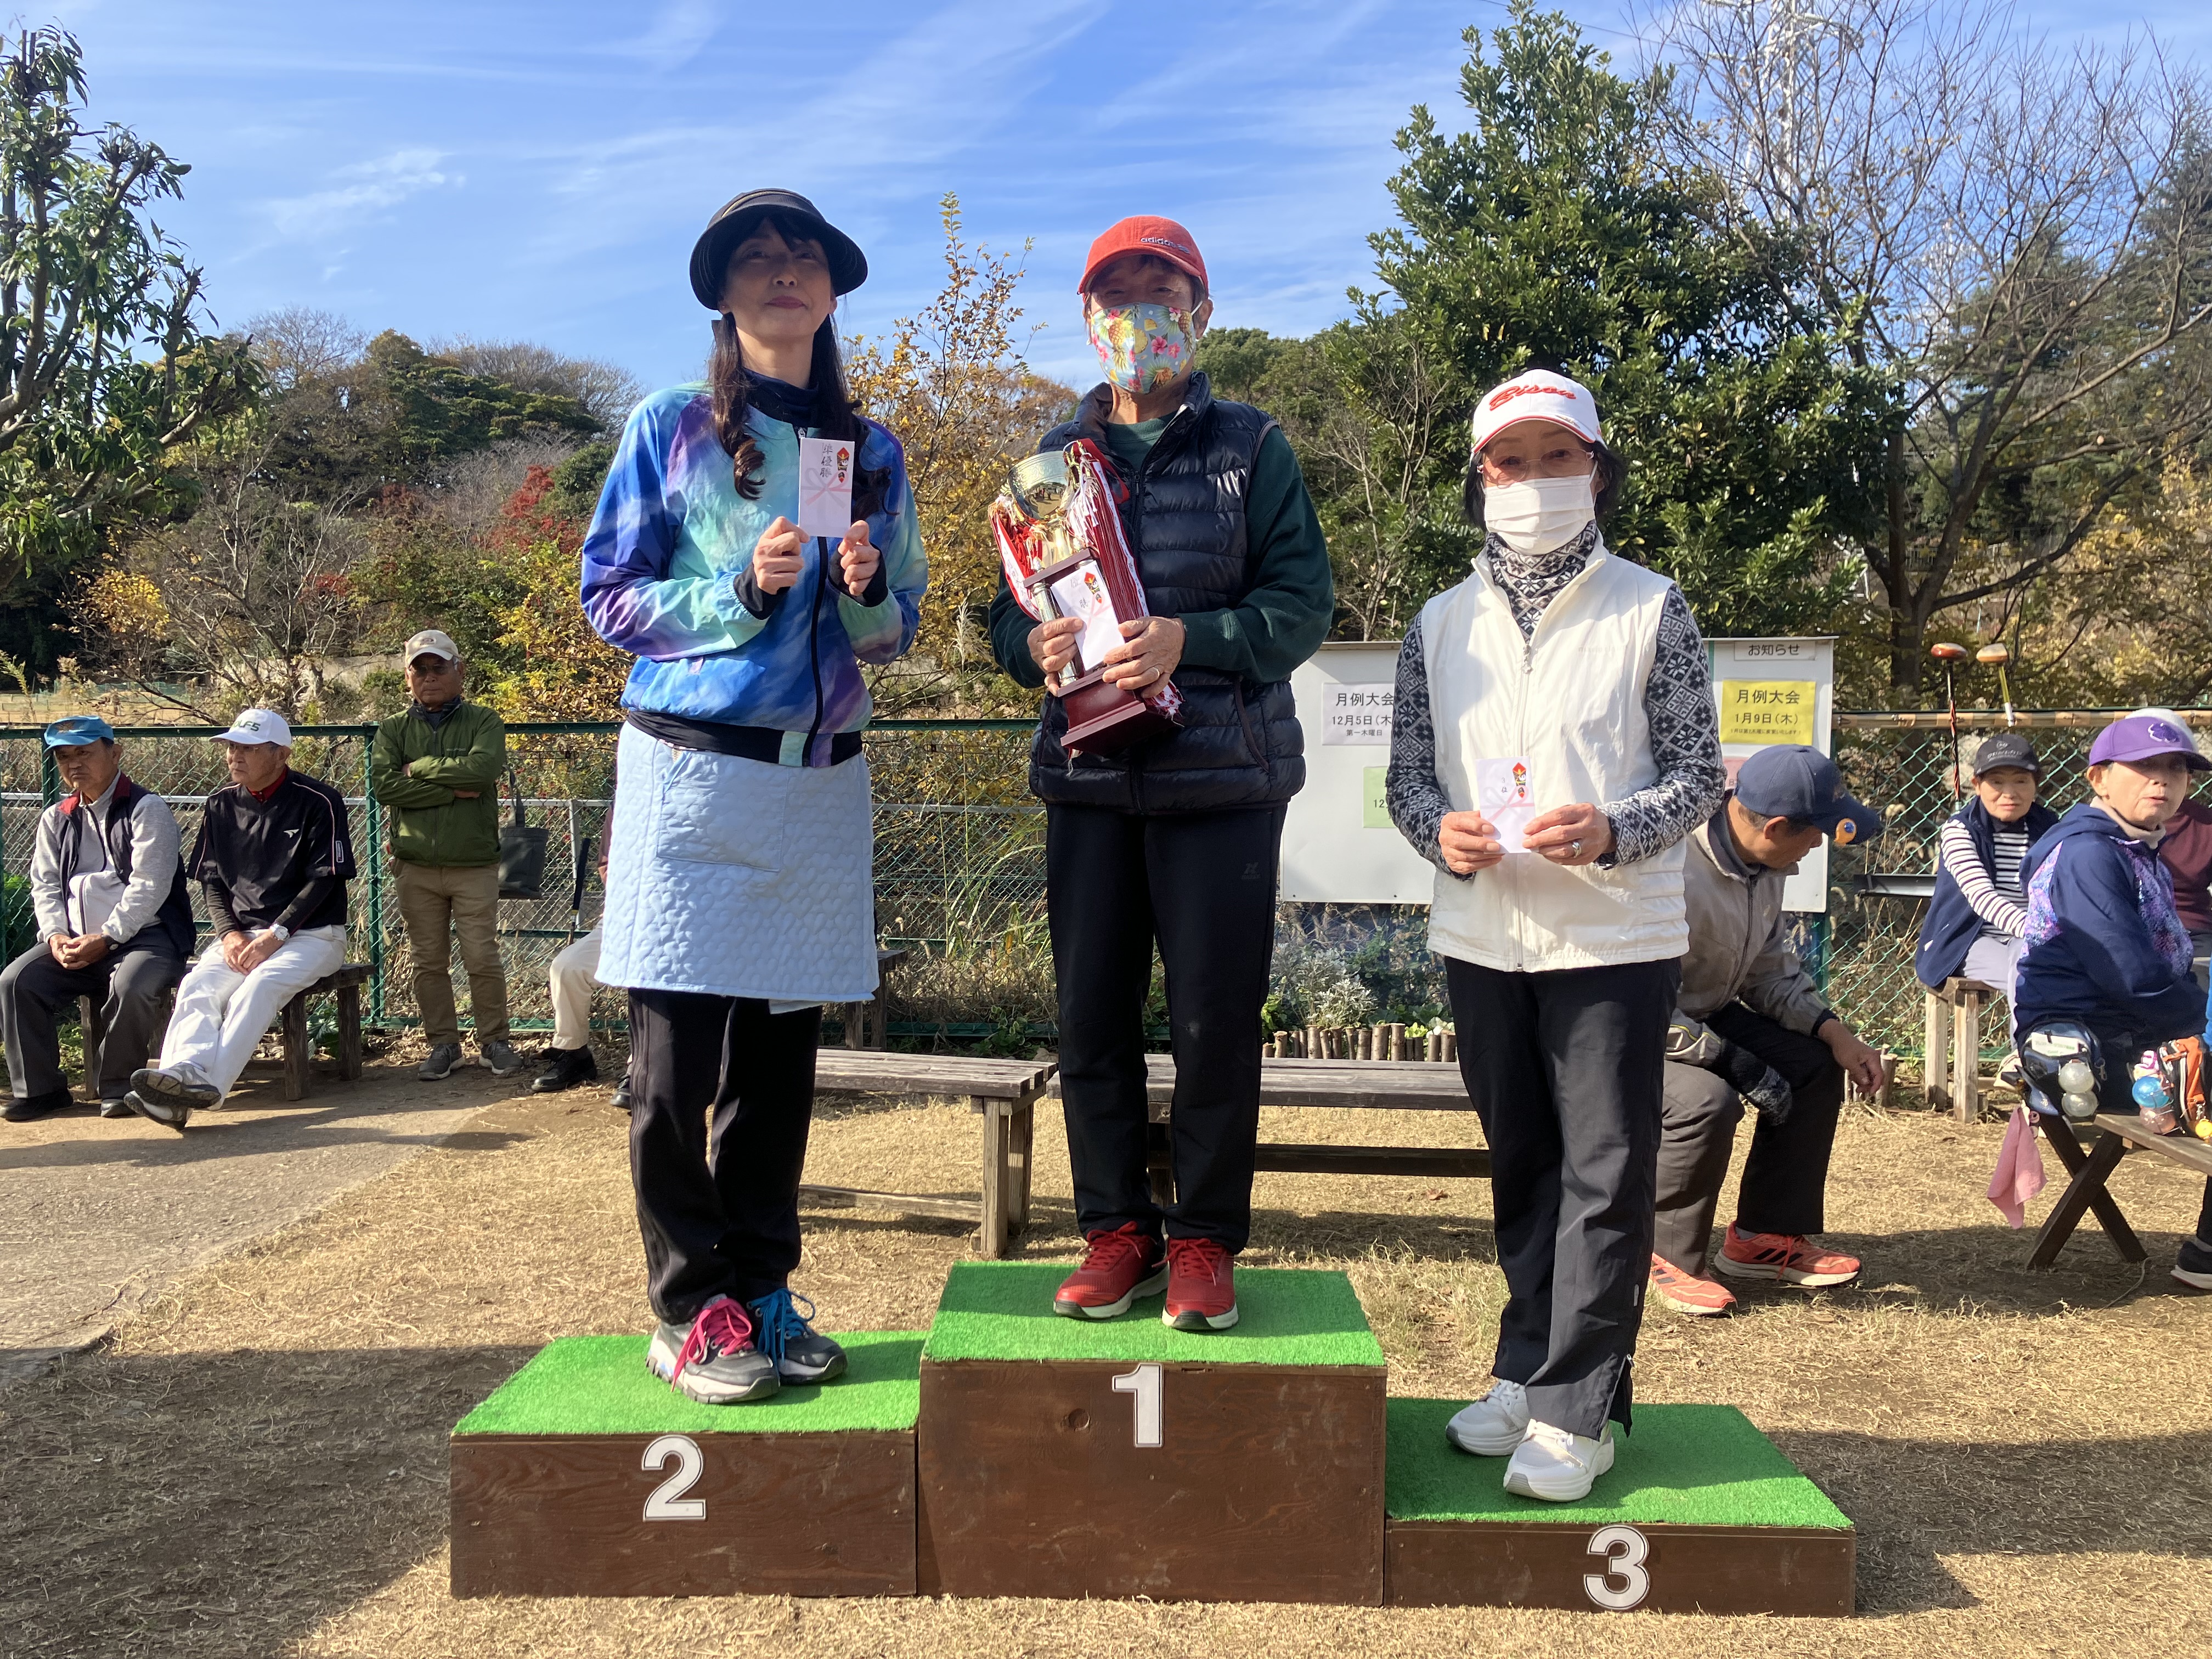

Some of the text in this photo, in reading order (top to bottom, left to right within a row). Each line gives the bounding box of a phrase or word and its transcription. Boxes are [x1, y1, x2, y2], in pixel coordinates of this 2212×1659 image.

[1141, 236, 1176, 248] adidas
[820, 443, 833, 478] 準優勝
[1748, 644, 1801, 656] お知らせ
[1335, 692, 1394, 706] 月例大会
[1736, 690, 1800, 704] 月例大会
[234, 720, 261, 731] OLF5
[1332, 715, 1392, 726] 12月5日（木
[1373, 799, 1388, 809] 12
[1111, 1363, 1163, 1448] 1
[641, 1435, 707, 1521] 2
[1583, 1525, 1650, 1611] 3
